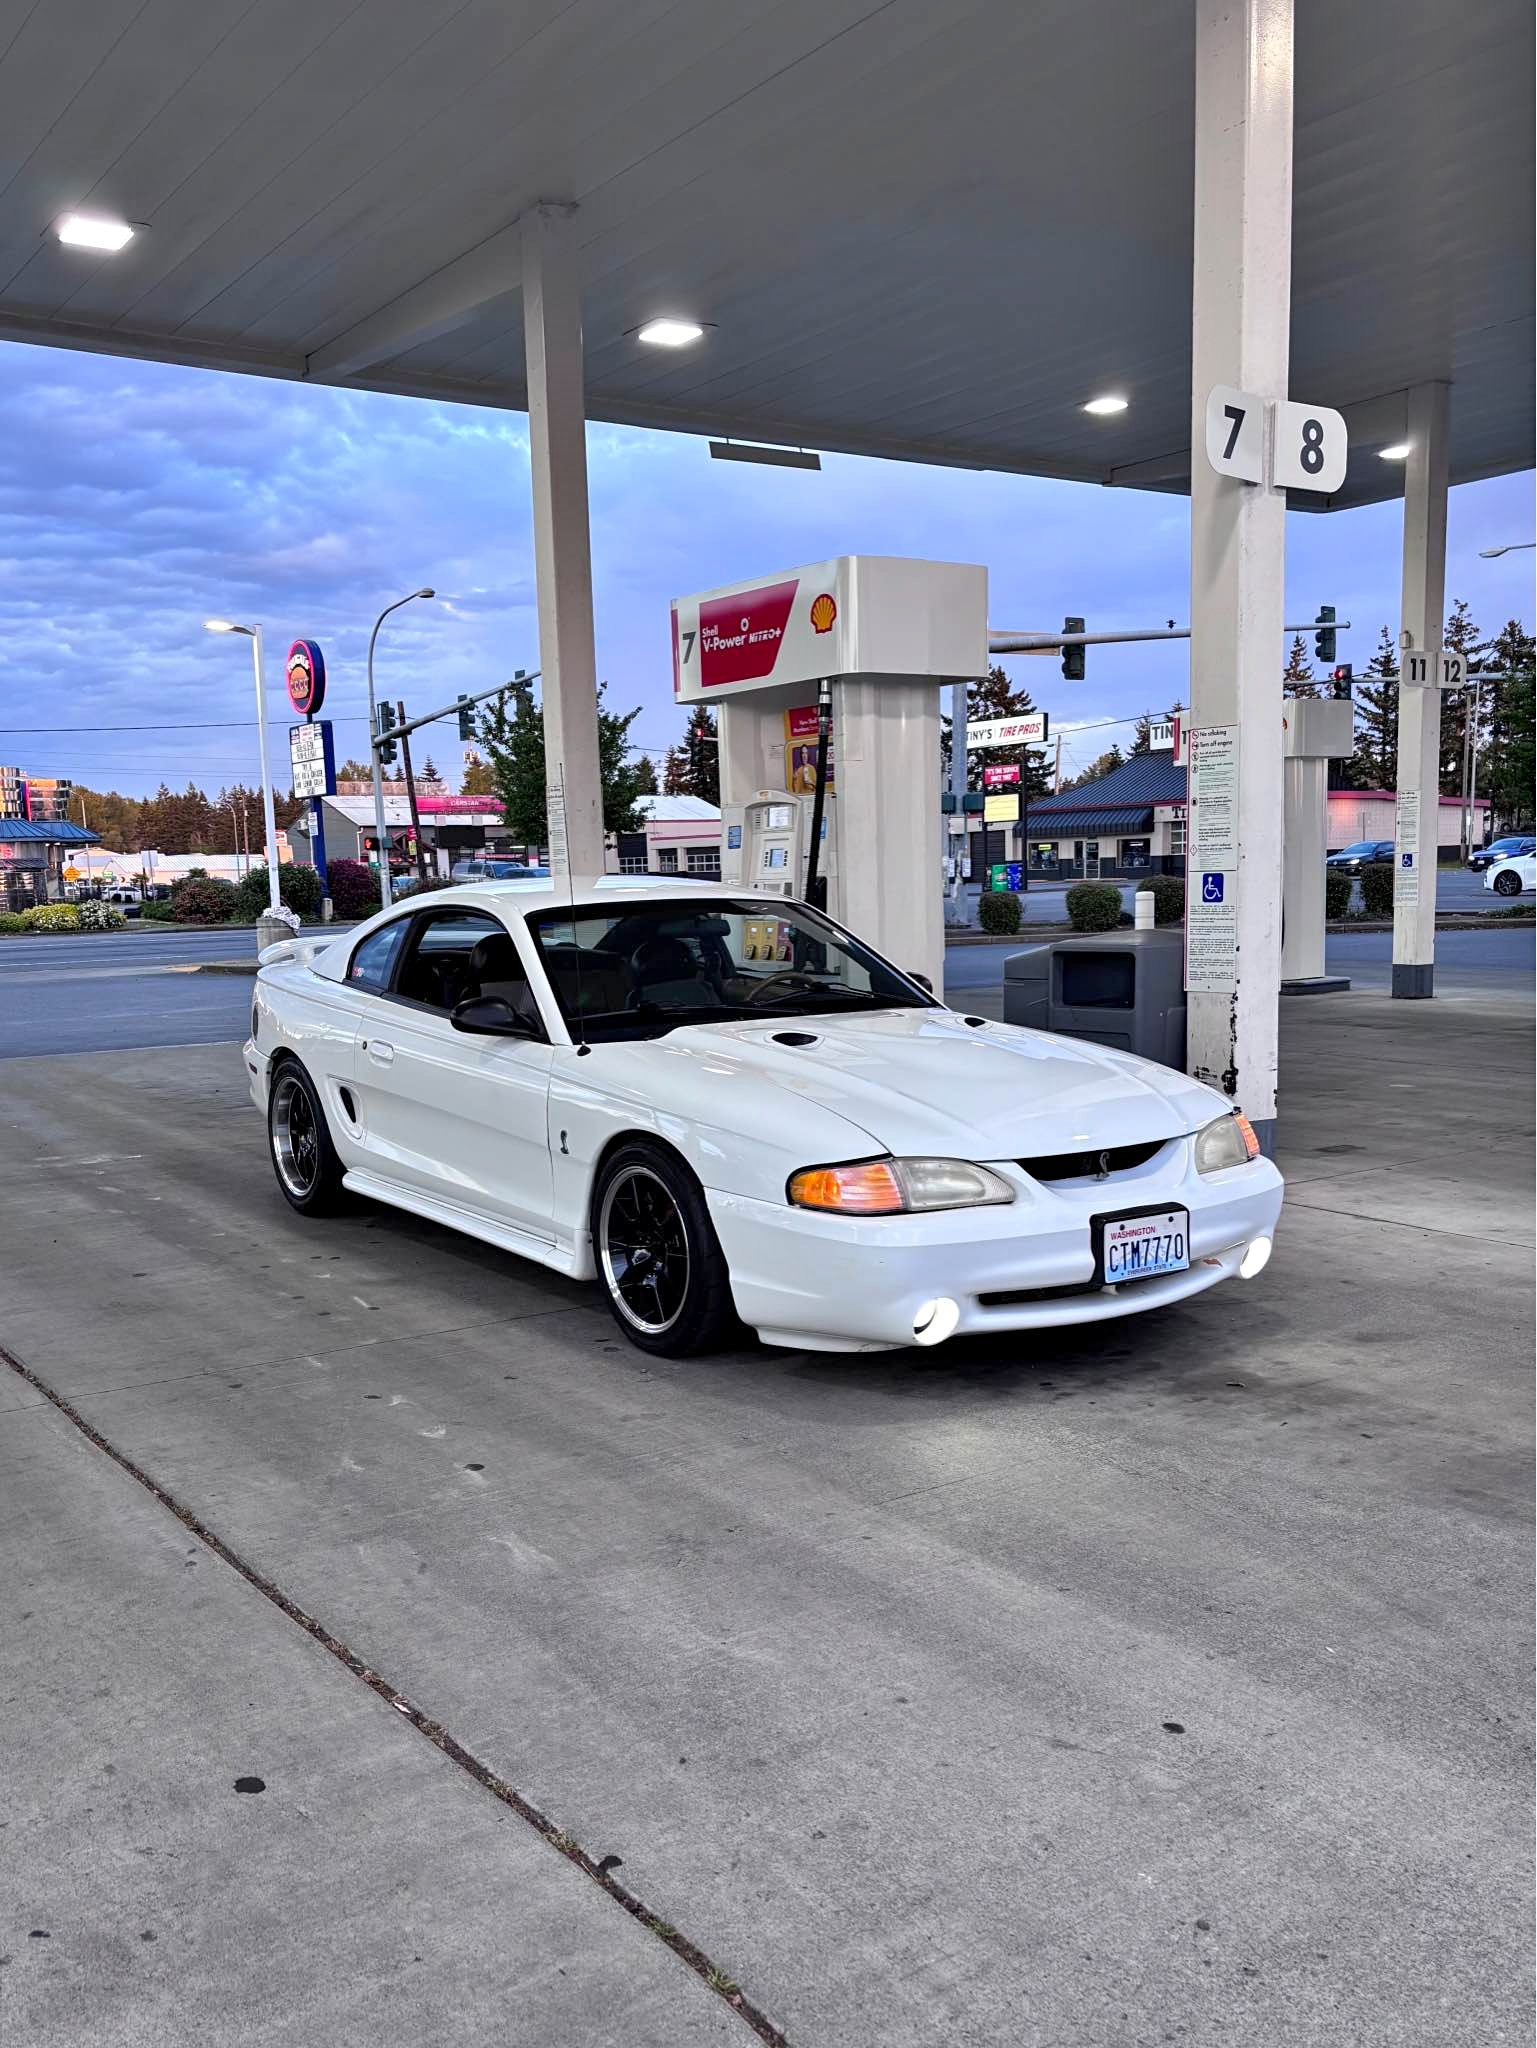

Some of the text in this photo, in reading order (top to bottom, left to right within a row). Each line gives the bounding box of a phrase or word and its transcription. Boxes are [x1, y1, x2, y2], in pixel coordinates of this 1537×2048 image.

[1223, 404, 1246, 460] 7
[1300, 419, 1325, 475] 8
[702, 625, 719, 639] Shell
[703, 634, 745, 652] V-Power
[682, 631, 697, 665] 7
[1410, 658, 1426, 681] 11
[1443, 660, 1461, 683] 12
[999, 726, 1017, 738] TIRE
[1018, 723, 1041, 736] PROS
[1111, 1226, 1156, 1240] WASHINGTON
[1109, 1233, 1184, 1273] CTM7770
